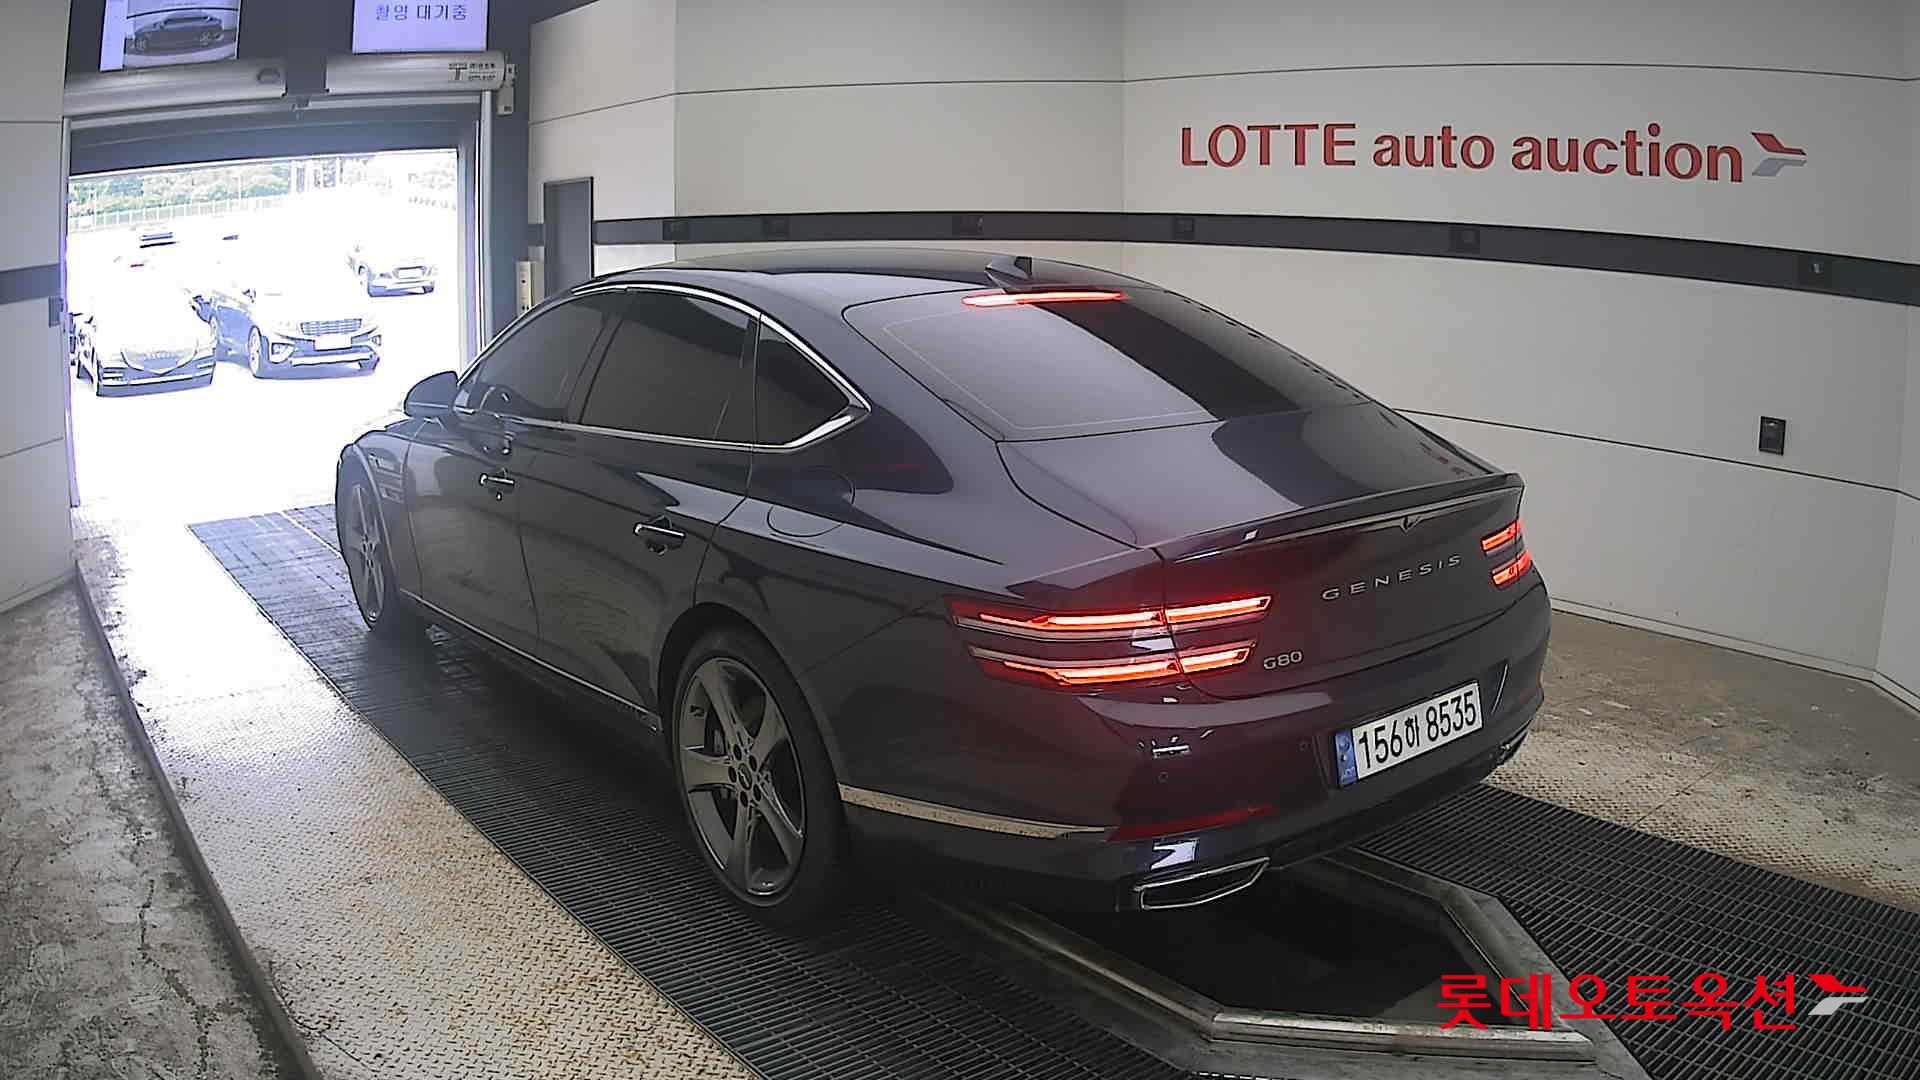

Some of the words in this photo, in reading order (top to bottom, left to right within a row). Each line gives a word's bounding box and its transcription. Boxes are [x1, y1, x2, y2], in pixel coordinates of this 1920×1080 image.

[416, 4, 466, 21] 대기중
[1181, 123, 1356, 168] LOTTE
[1372, 125, 1495, 170] auto
[1511, 122, 1743, 183] auction
[1322, 555, 1461, 600] GENESIS
[1263, 650, 1303, 670] G80
[1358, 714, 1420, 769] 156하
[1426, 690, 1477, 743] 8535
